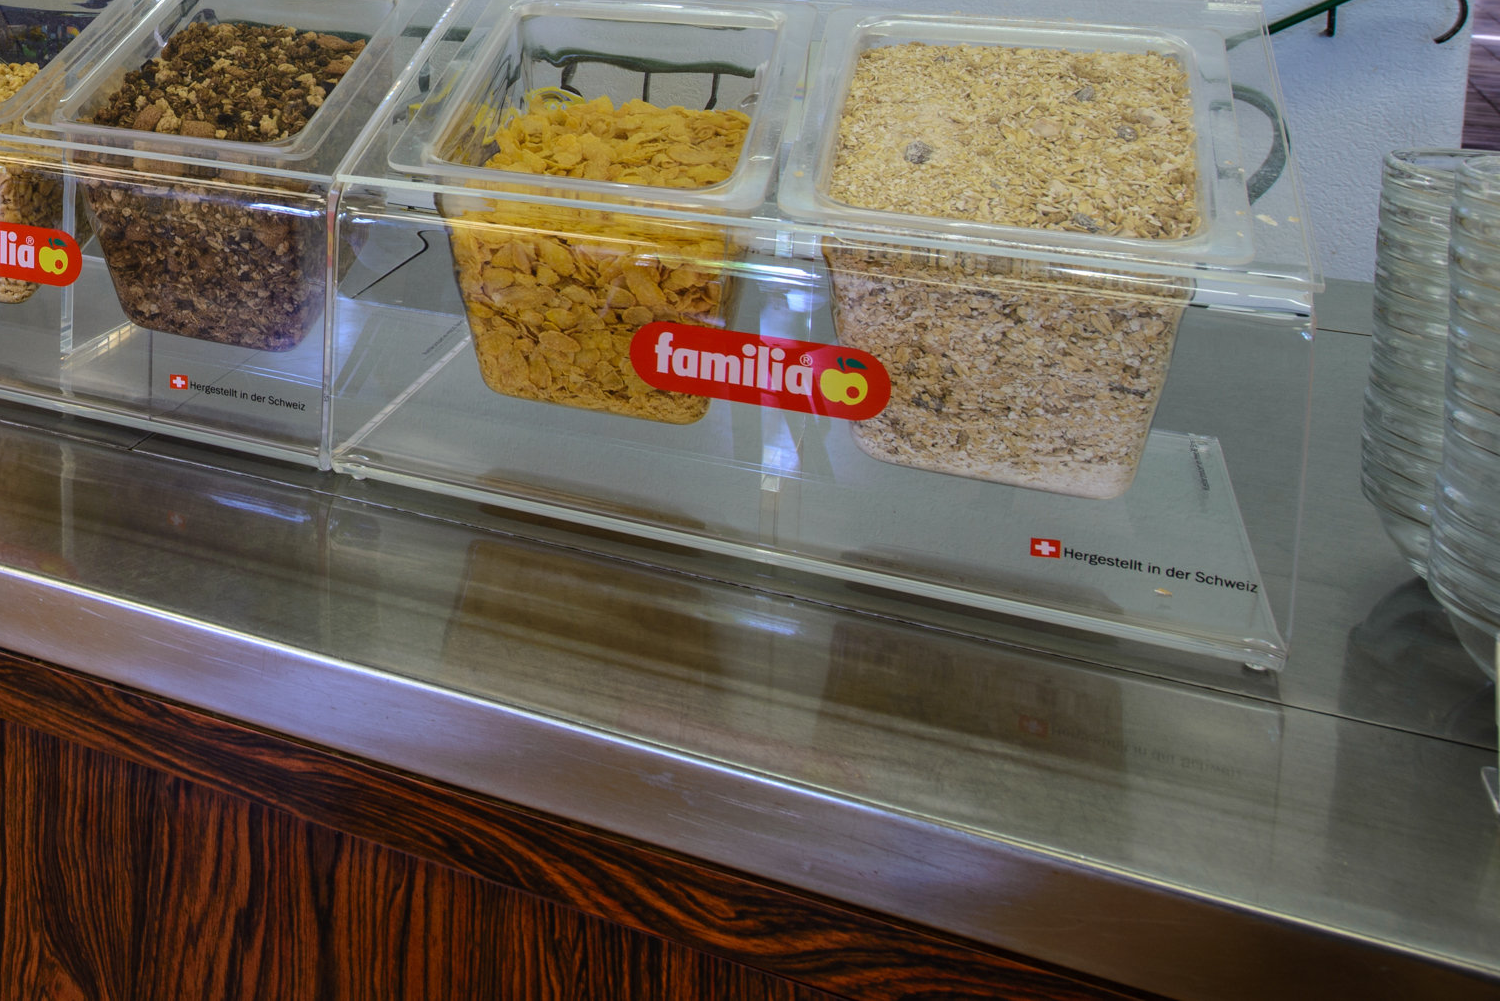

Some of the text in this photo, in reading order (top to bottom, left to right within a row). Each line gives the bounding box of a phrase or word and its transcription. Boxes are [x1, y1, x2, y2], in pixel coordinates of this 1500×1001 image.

[654, 332, 814, 396] familia
[190, 380, 306, 411] Hergestellt in der Schweiz
[1064, 547, 1258, 594] Hergestellt in der Schweiz
